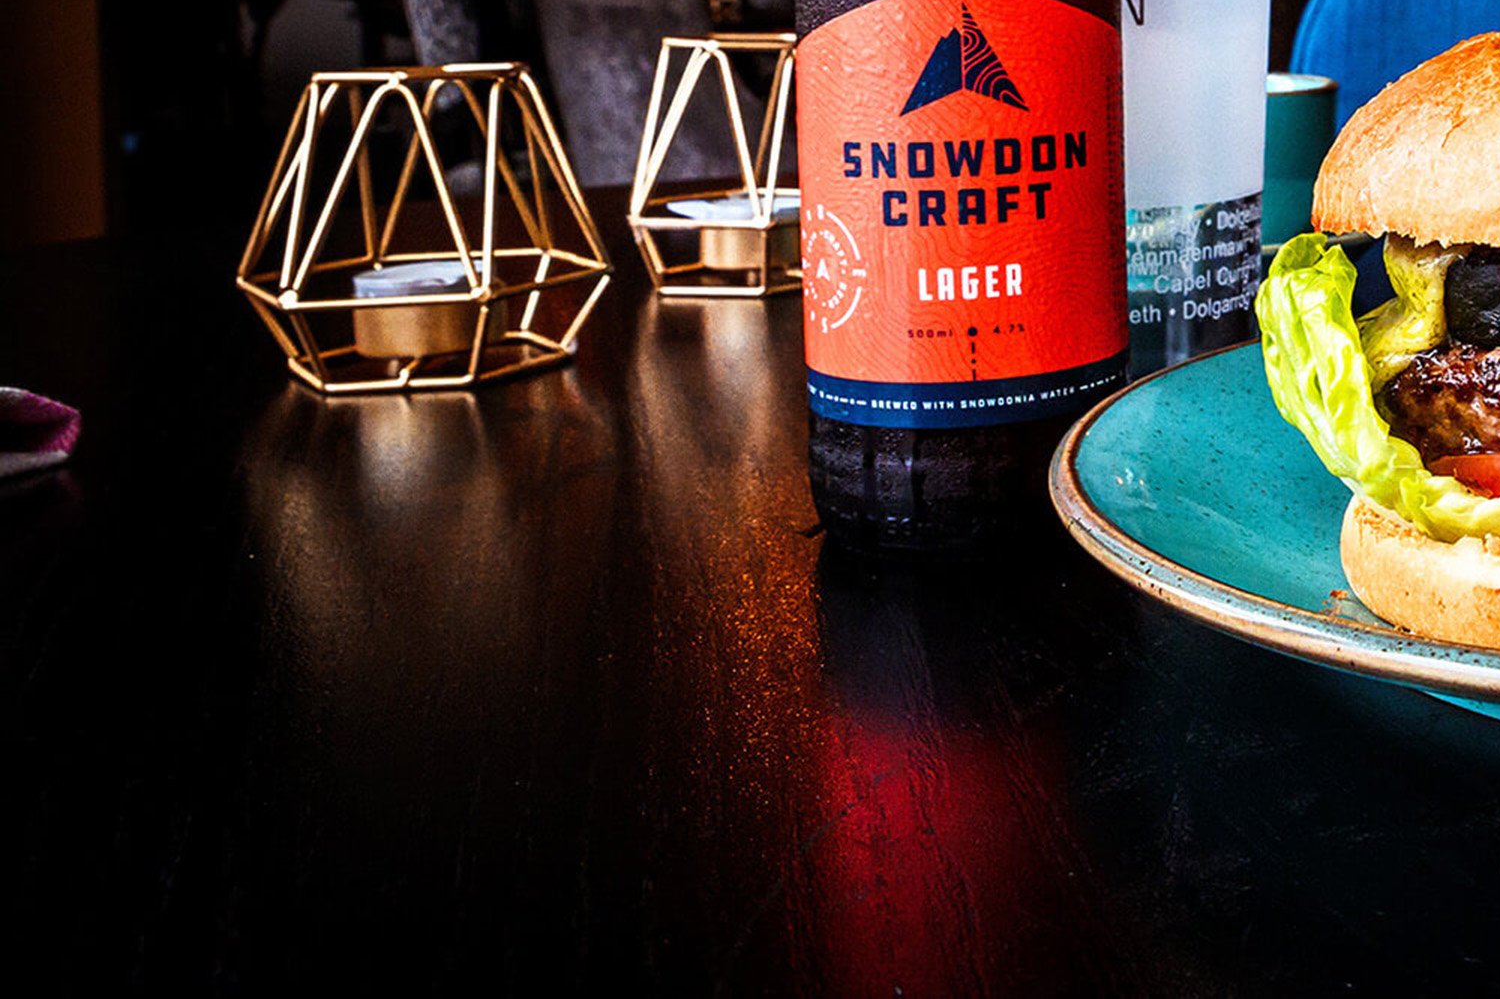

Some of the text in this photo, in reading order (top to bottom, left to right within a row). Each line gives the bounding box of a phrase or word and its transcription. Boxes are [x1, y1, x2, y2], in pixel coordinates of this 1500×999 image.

[843, 131, 1087, 179] SNOWDON
[882, 183, 1052, 227] CRAFT
[917, 263, 1023, 301] LAGER
[1153, 268, 1211, 297] Capel
[907, 328, 953, 338] 500ml
[870, 385, 1075, 411] BREWED WITH SNOWDONIA WATER
